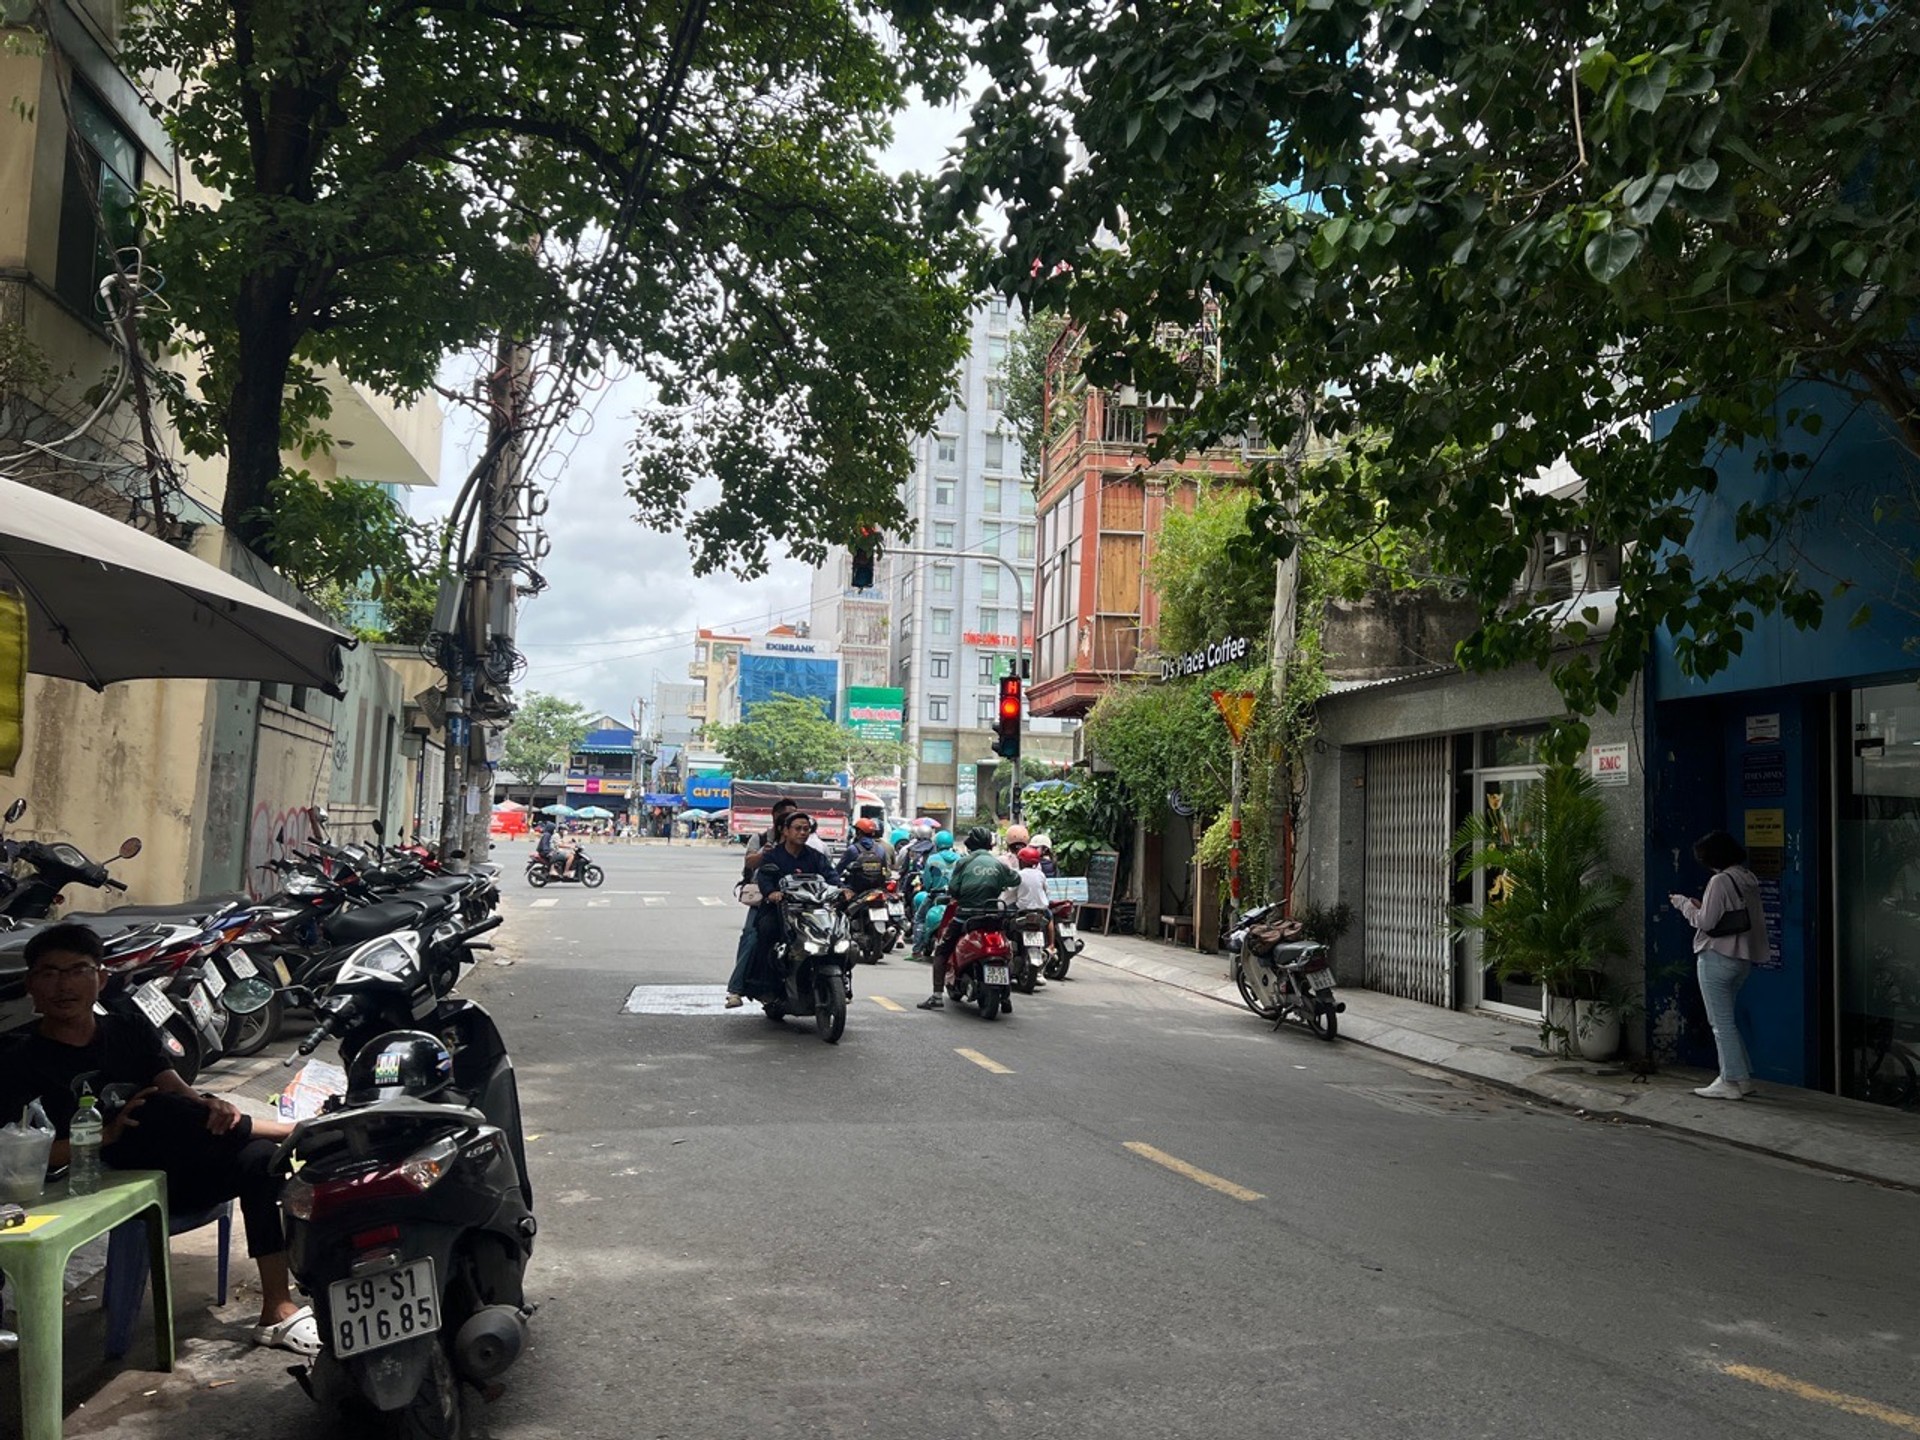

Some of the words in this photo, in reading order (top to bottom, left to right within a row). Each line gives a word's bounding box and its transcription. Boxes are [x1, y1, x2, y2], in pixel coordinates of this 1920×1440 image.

[765, 643, 815, 653] EXIMBANK
[1176, 651, 1205, 677] Place
[1207, 635, 1246, 668] Coffee
[1599, 755, 1621, 771] EMC
[693, 787, 731, 798] GUTA
[345, 1267, 416, 1313] 59-S1
[340, 1296, 433, 1350] 816.85
